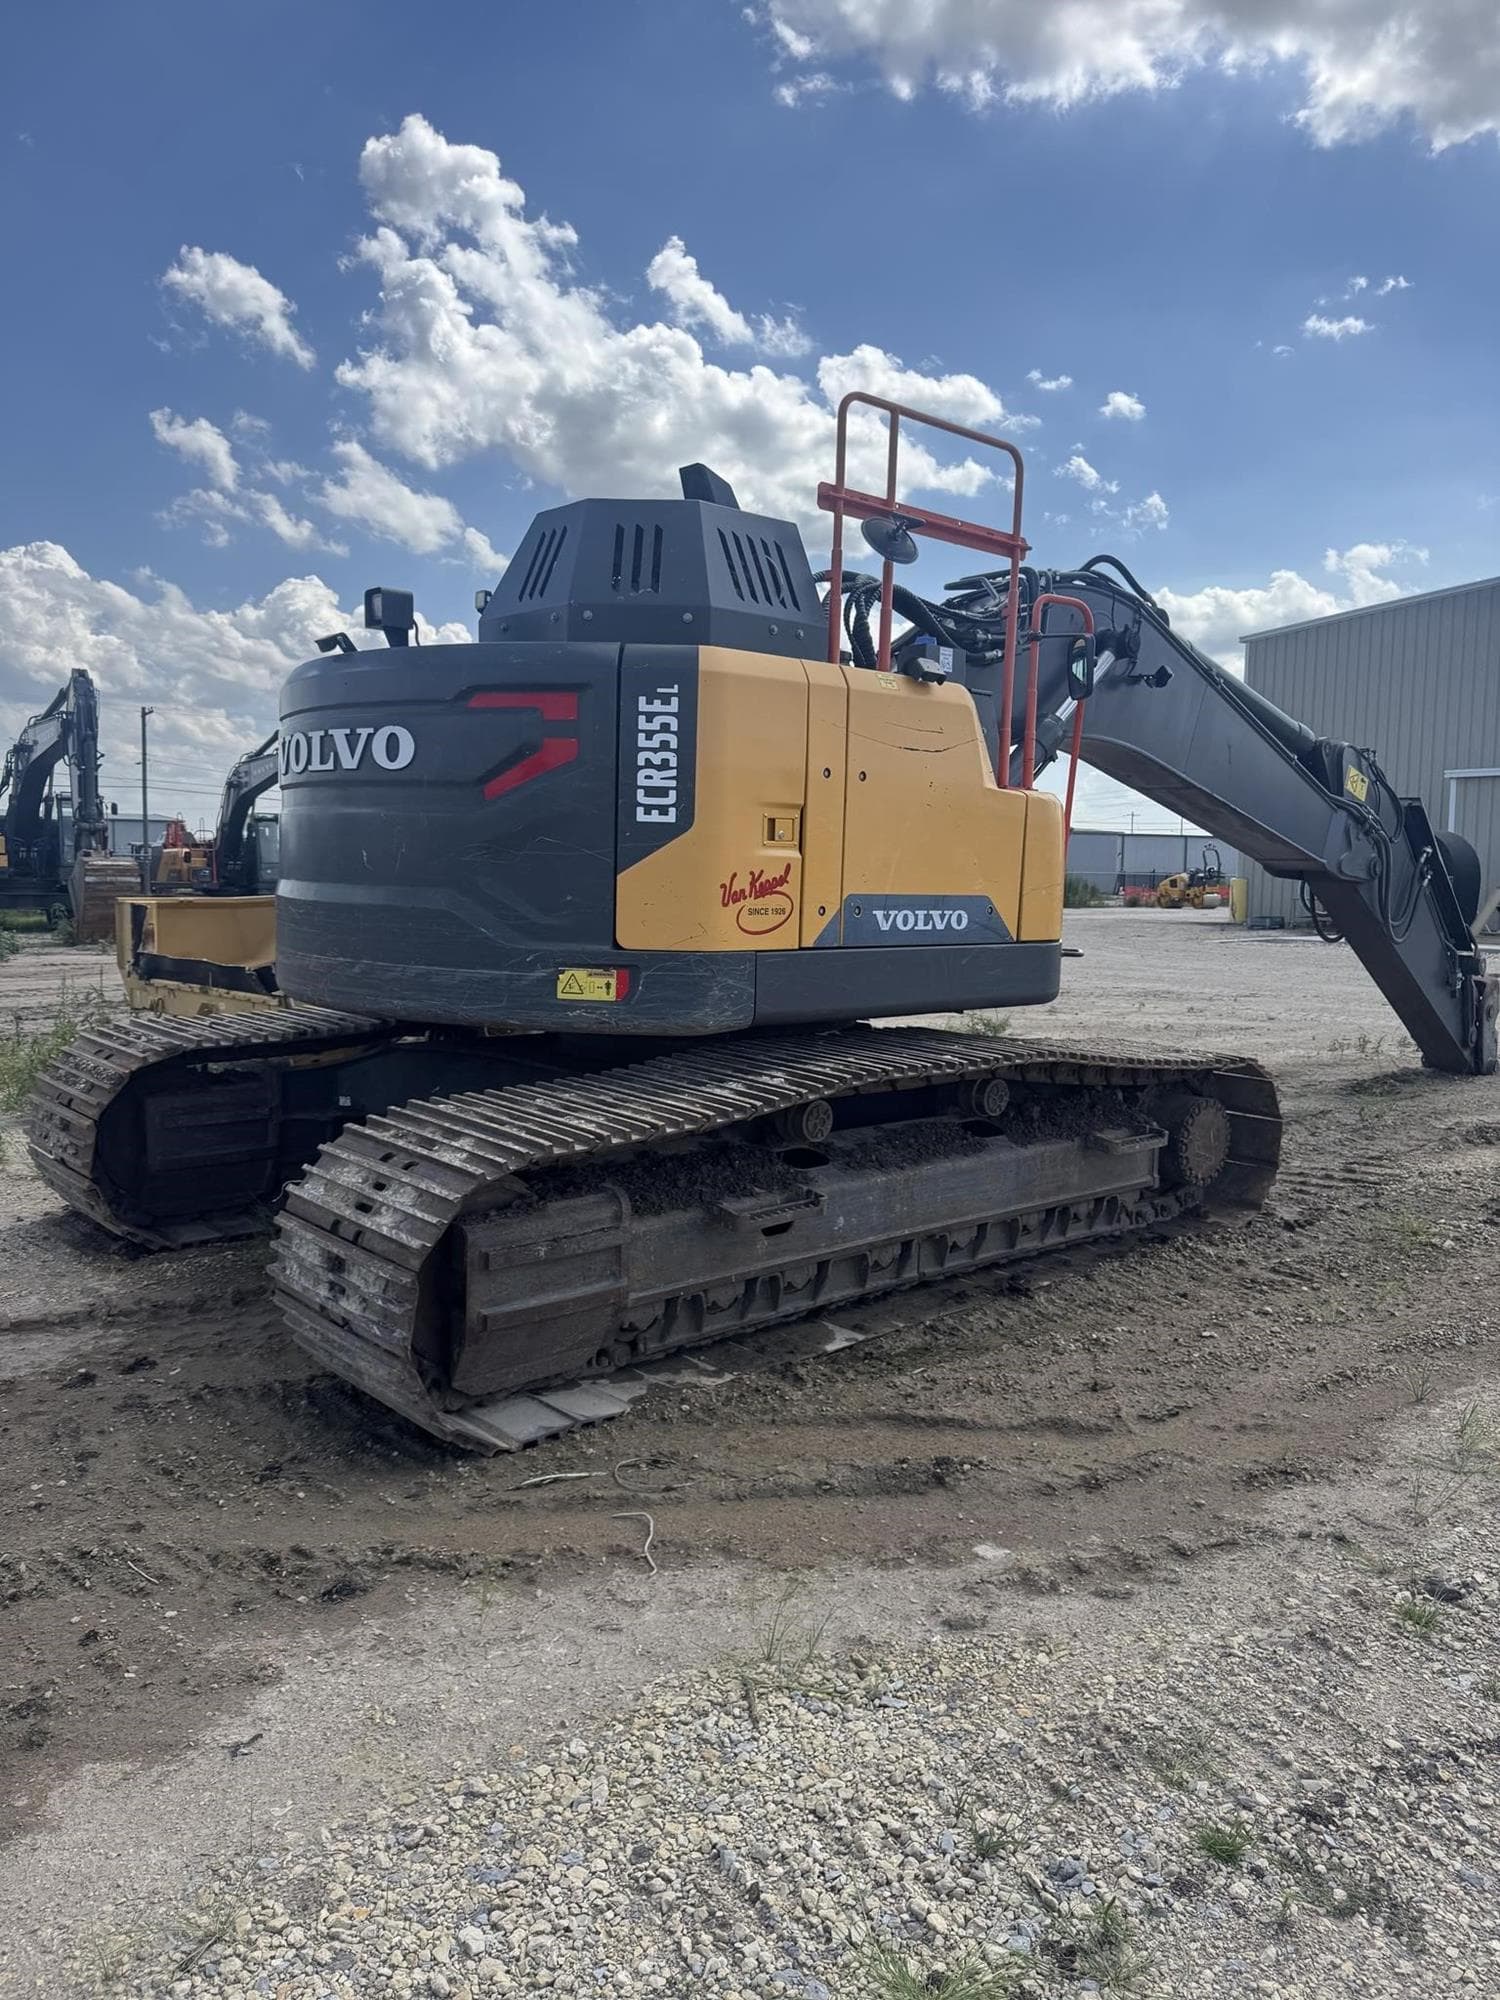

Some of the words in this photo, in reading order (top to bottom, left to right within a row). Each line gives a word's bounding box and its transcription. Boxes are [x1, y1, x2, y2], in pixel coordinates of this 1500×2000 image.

[280, 725, 415, 775] VOLVO
[720, 872, 748, 907] Van
[747, 907, 770, 916] SINCE
[771, 907, 787, 916] 1926
[872, 910, 969, 931] VOLVO
